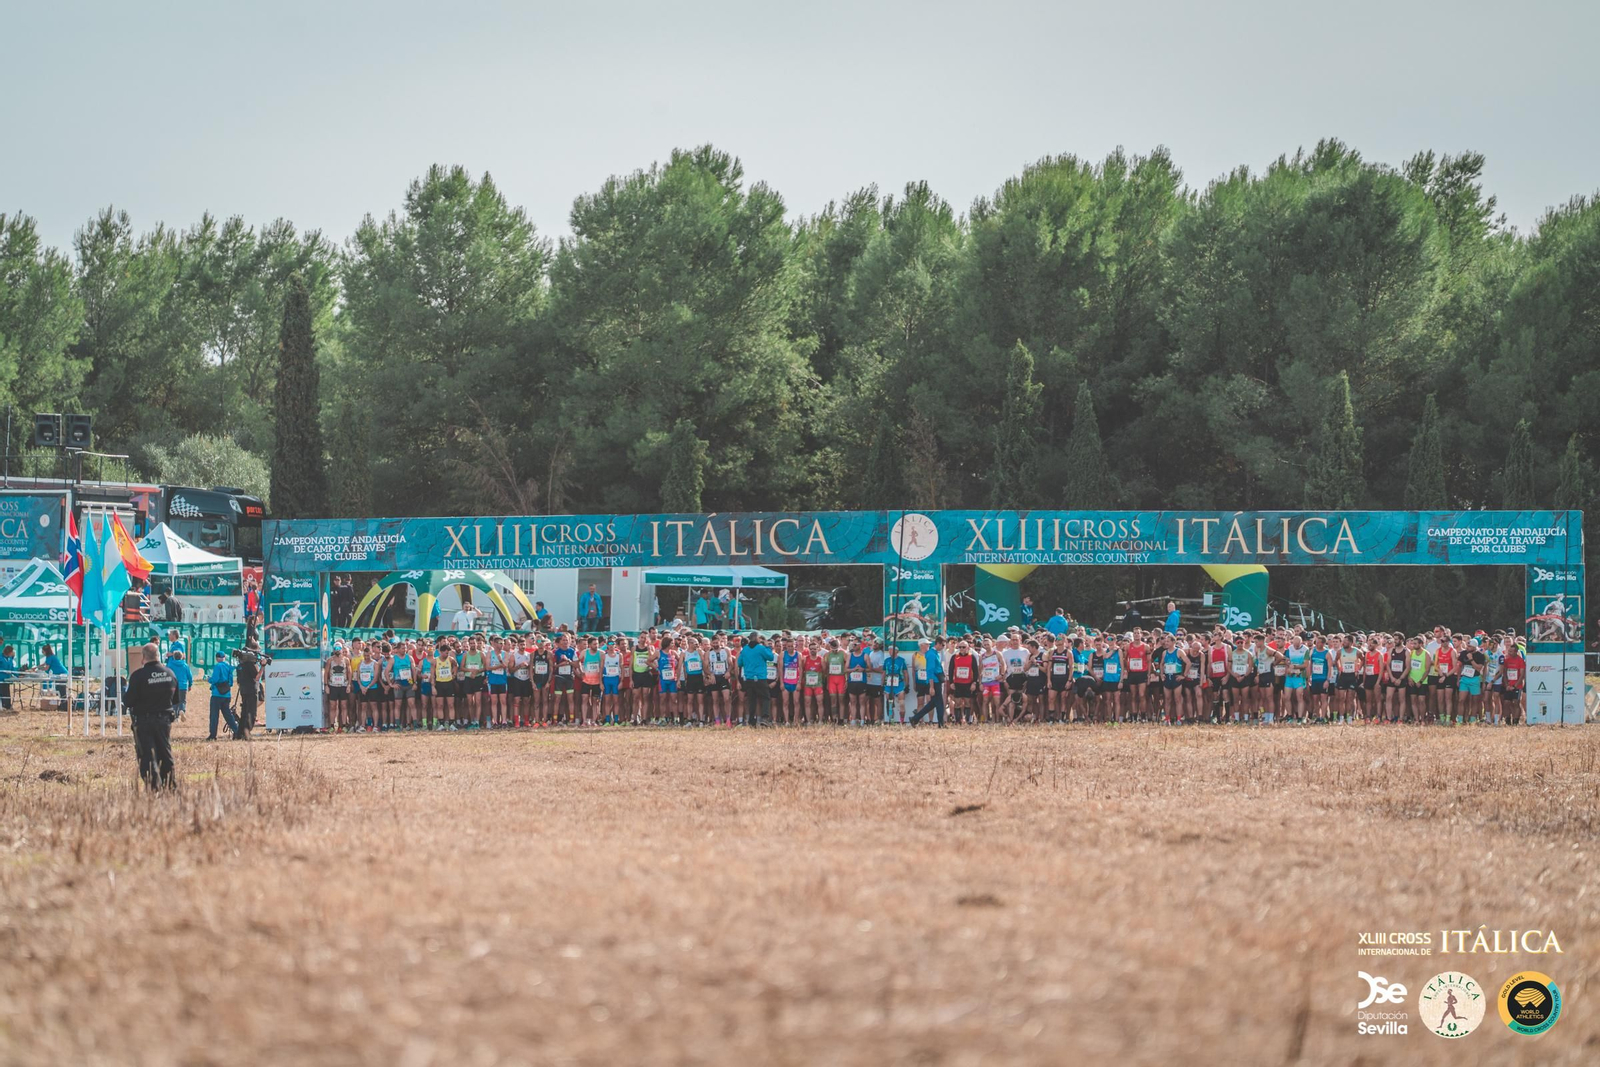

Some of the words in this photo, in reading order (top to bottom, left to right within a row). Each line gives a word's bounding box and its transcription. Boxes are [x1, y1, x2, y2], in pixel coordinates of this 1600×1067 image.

[650, 512, 834, 557] ITÁLICA
[965, 518, 1062, 551] XLIII
[1064, 519, 1141, 539] CROSS
[1175, 511, 1362, 555] ITÁLICA
[1427, 527, 1494, 537] CAMPEONATO
[1495, 527, 1508, 536] DE
[1510, 527, 1567, 537] ANDALUCÍA
[273, 536, 336, 546] CAMPEONATO
[337, 536, 350, 545] DE
[351, 533, 406, 544] ANDALUCÍA
[444, 524, 540, 557] XLIII
[541, 523, 616, 543] CROSS
[1449, 537, 1463, 545] DE
[1463, 536, 1499, 545] CAMPO
[1500, 537, 1508, 545] A
[1509, 535, 1546, 545] TRAVÉS
[293, 545, 305, 553] DE
[306, 544, 340, 553] CAMPO
[342, 544, 350, 552] A
[351, 543, 386, 552] TRAVÉS
[541, 543, 644, 556] INTERNACIONAL
[1064, 540, 1169, 551] INTERNACIONAL
[1471, 545, 1490, 553] POR
[1492, 545, 1527, 553] CLUBES
[314, 553, 333, 561] POR
[334, 553, 367, 561] CLUBES
[965, 553, 1057, 563] INTERNATIONAL
[1058, 553, 1094, 563] CROSS
[1095, 553, 1150, 563] COUNTRY
[443, 559, 534, 570] INTERNATIONAL
[536, 557, 570, 568] CROSS
[572, 556, 626, 567] COUNTRY
[693, 575, 711, 583] Sevilla
[9, 611, 48, 620] Diputación
